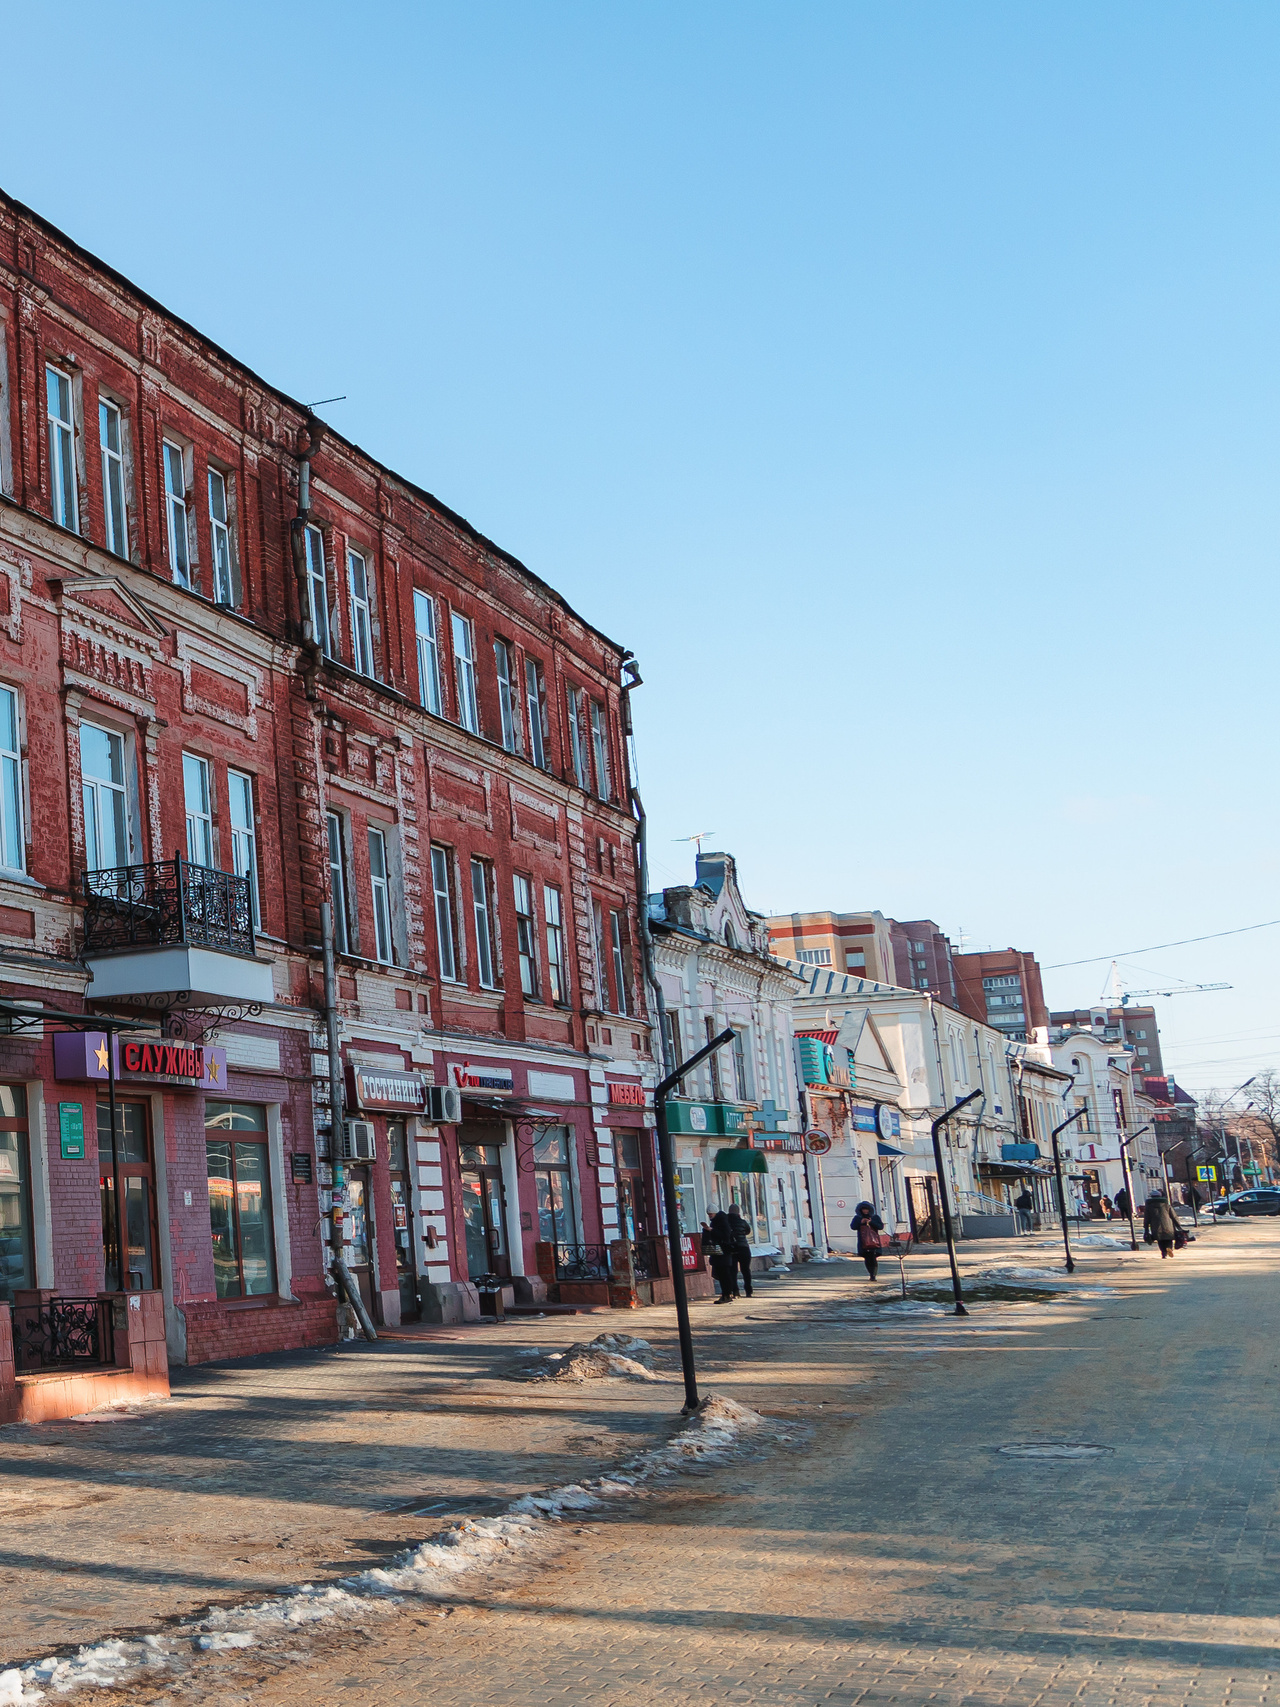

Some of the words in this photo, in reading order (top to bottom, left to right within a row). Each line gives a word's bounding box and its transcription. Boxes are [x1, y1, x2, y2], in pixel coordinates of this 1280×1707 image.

[125, 1043, 204, 1078] СЛУЖИВЫ
[362, 1075, 423, 1106] ГОСТИНИЦА
[610, 1083, 646, 1105] МЕБЕЛЬ
